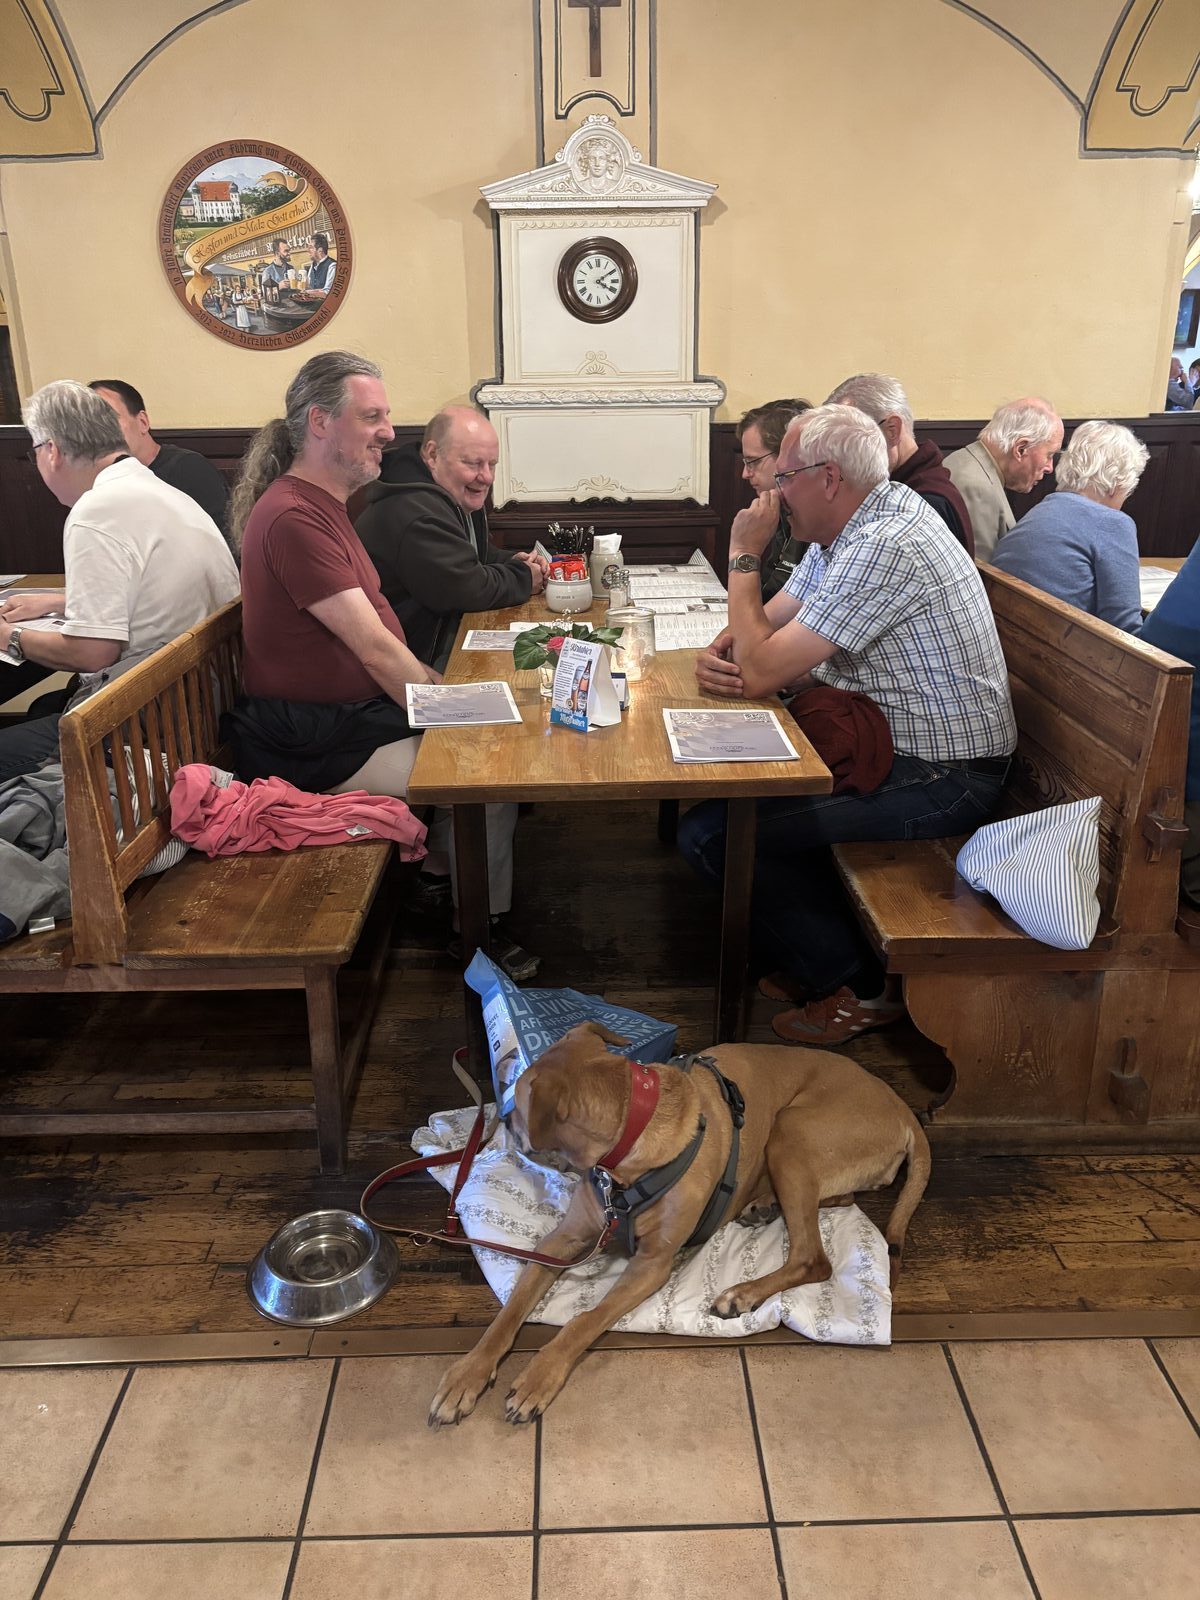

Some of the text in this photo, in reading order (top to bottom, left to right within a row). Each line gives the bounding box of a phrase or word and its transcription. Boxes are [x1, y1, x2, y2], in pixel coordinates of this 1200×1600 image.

[166, 249, 180, 272] Jahre
[265, 147, 279, 159] von
[282, 154, 312, 178] Florian
[313, 176, 335, 206] Geiger
[336, 228, 350, 263] Patrick
[192, 237, 223, 263] Hopfen
[224, 227, 238, 240] und
[239, 218, 265, 235] Malz
[267, 211, 288, 230] Gott
[195, 309, 212, 326] 2012
[219, 327, 236, 340] 2022
[239, 332, 282, 347] Herzlichen
